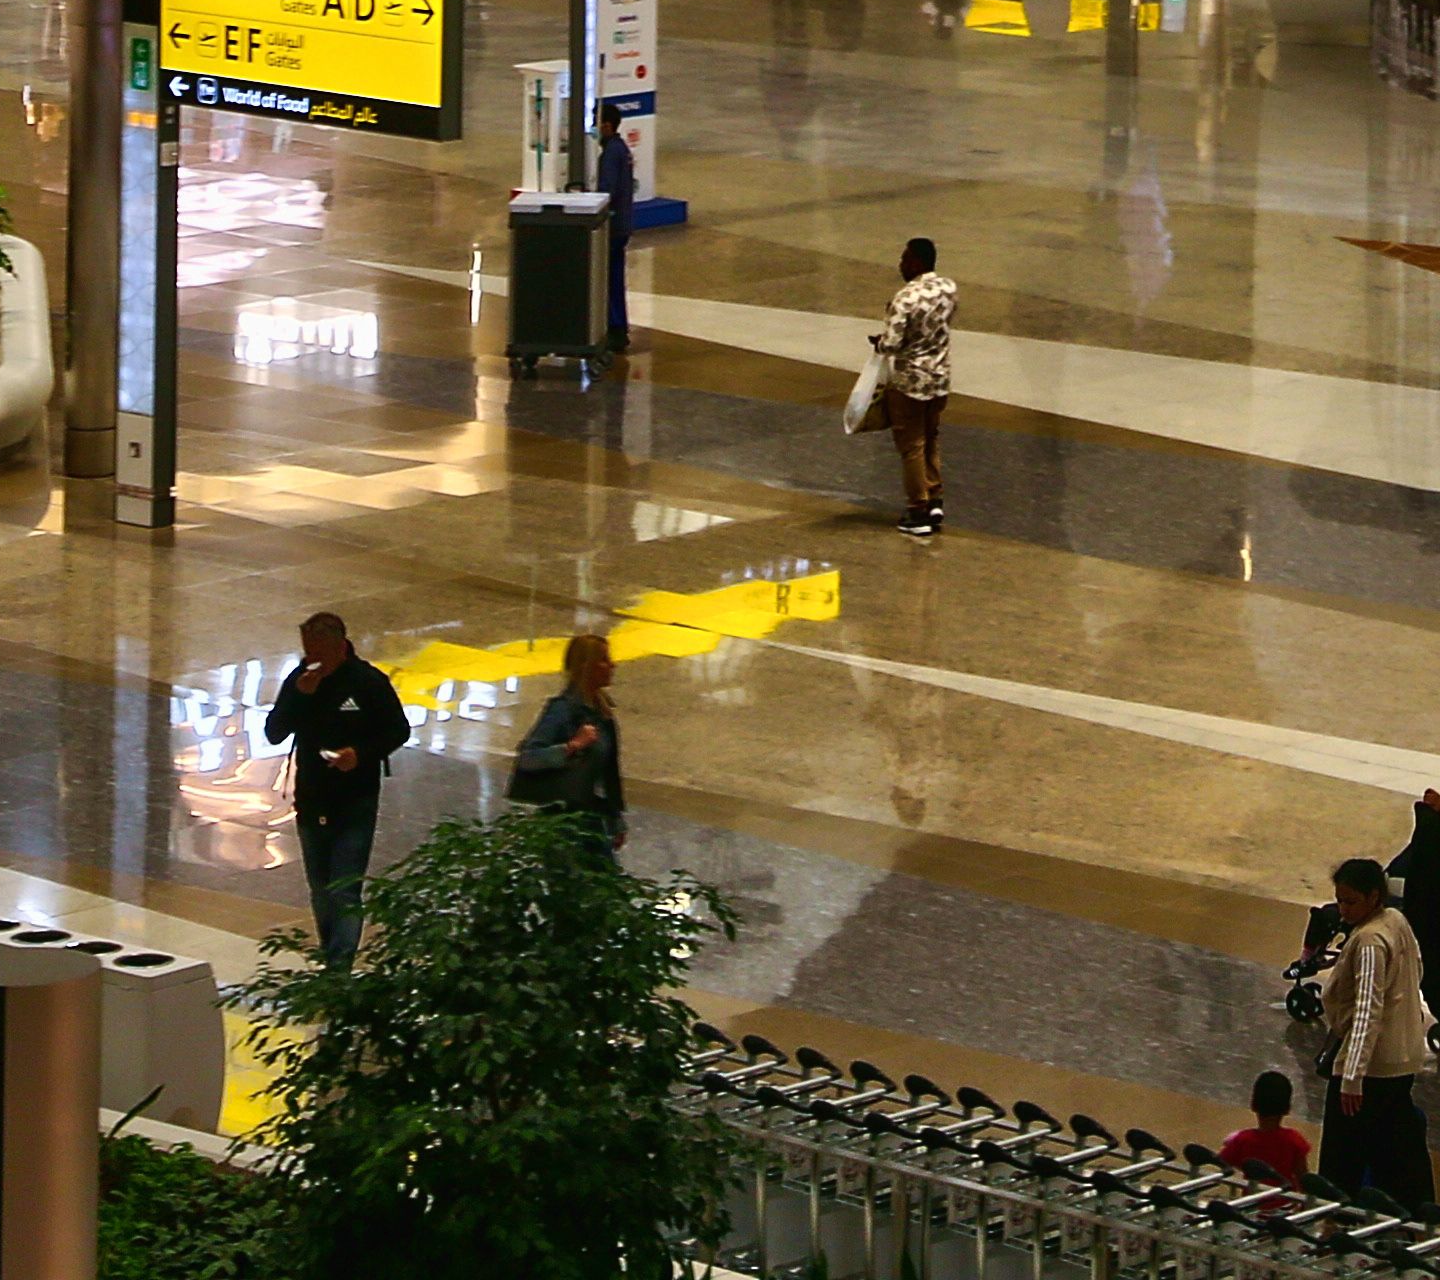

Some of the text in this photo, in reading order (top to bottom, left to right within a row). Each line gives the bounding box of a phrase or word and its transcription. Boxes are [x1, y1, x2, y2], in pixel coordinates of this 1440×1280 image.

[224, 25, 261, 63] E F
[265, 51, 302, 70] Gates
[222, 86, 309, 114] World of Food
